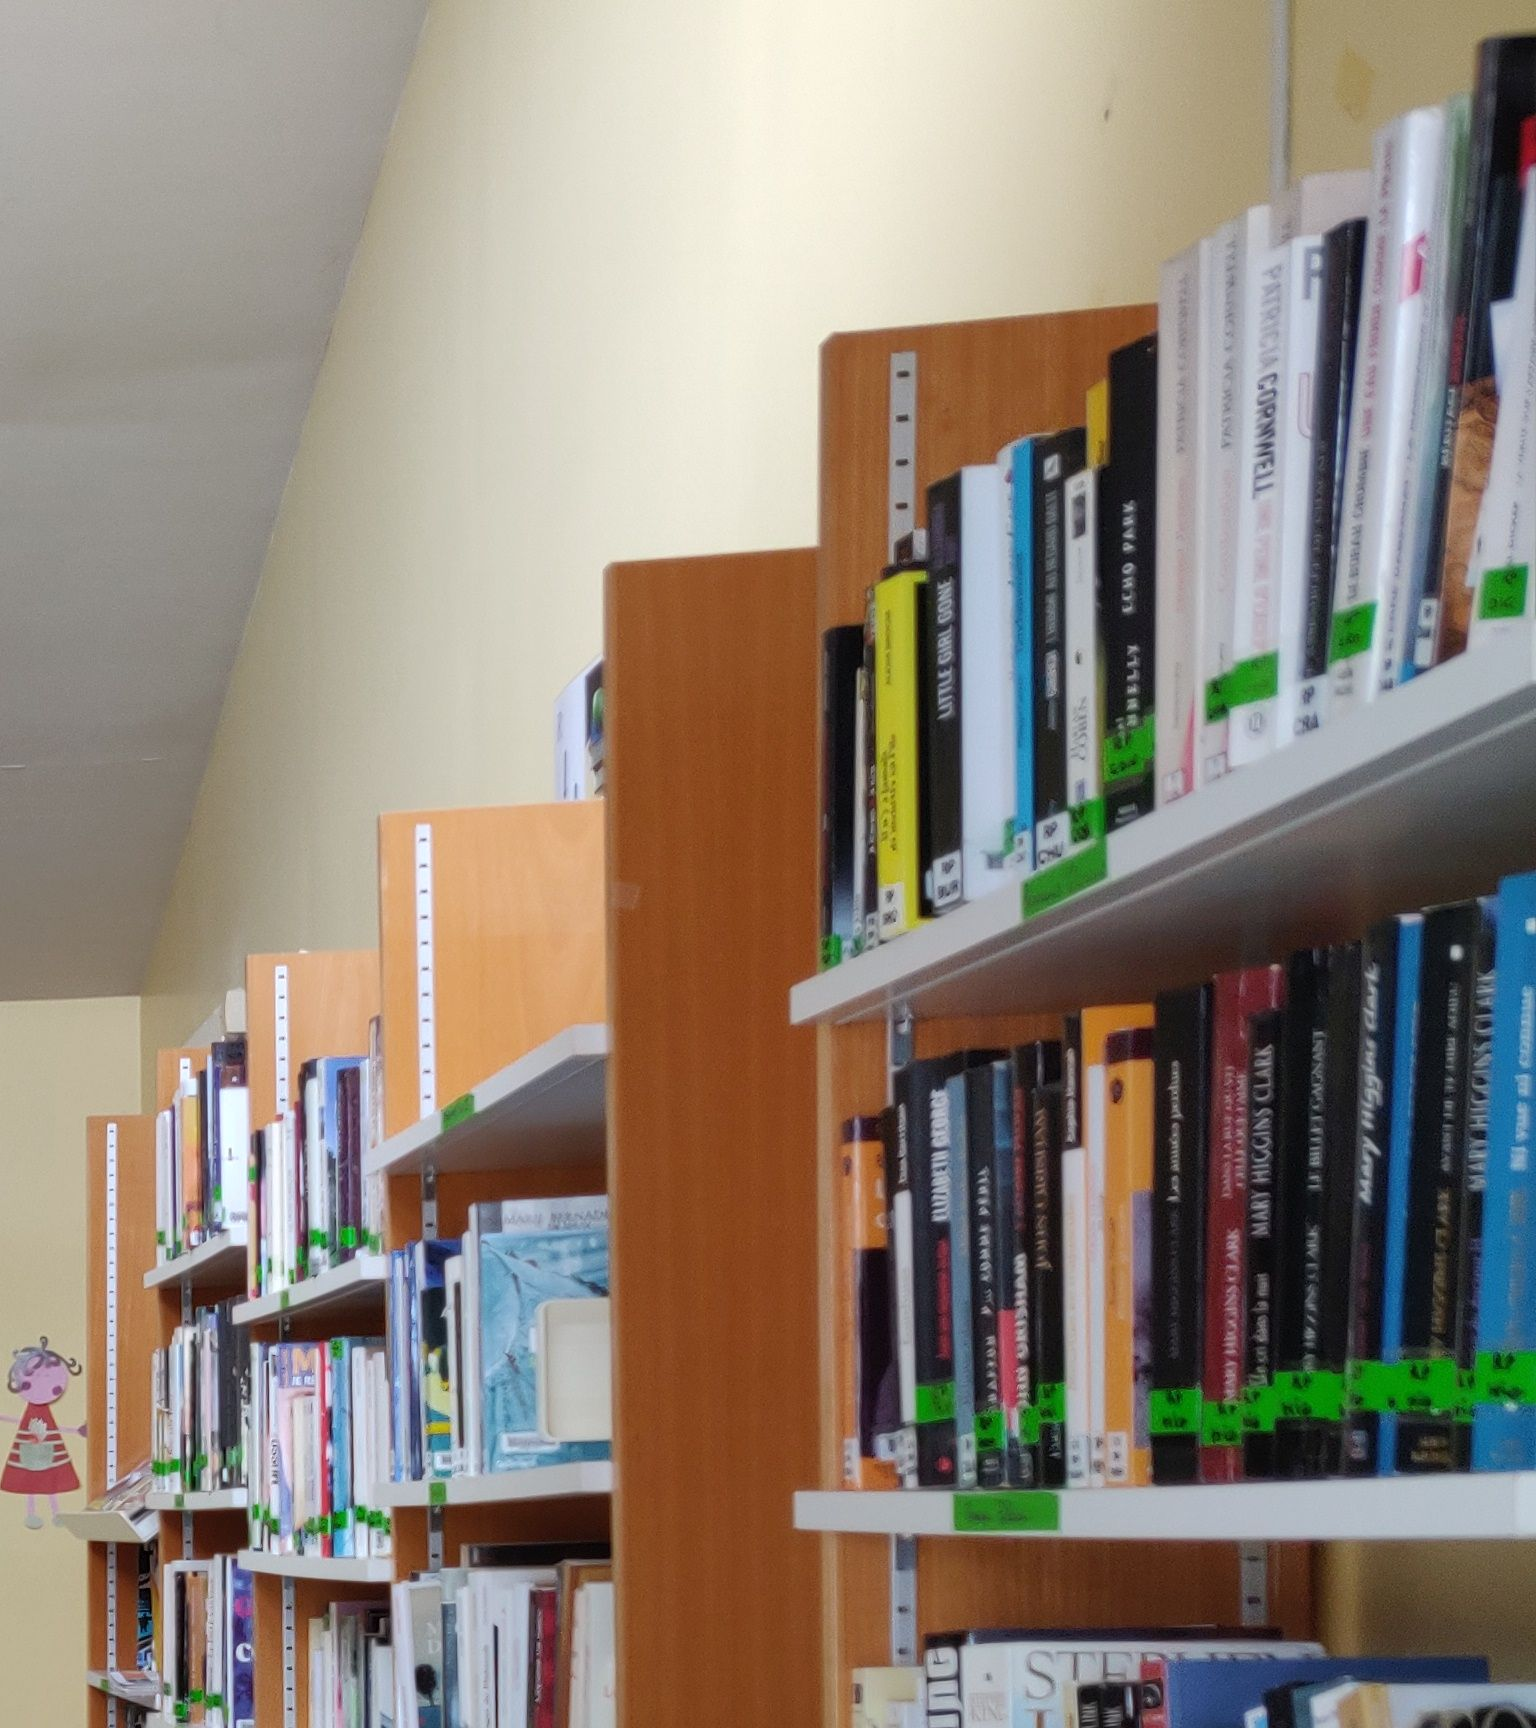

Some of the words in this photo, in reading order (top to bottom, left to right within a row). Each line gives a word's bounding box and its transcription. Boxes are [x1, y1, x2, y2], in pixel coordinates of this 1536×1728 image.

[1260, 265, 1282, 369] PATRICIA
[1251, 373, 1278, 499] CORNWELL
[1121, 500, 1137, 552] PARK
[936, 577, 954, 624] GONE
[1121, 562, 1137, 615] ECHO
[936, 626, 954, 664] GIRL
[936, 667, 955, 718] LITTLE
[1361, 962, 1379, 1035] Clark
[1472, 967, 1495, 1035] CLARK
[1168, 1060, 1183, 1118] perdues
[1251, 1044, 1274, 1102] CLARK
[1310, 1028, 1326, 1115] GAGNANT
[1358, 1041, 1383, 1130] Higgins
[1469, 1039, 1492, 1130] HIGGINS
[929, 1087, 948, 1148] GEORGE
[1250, 1107, 1273, 1184] HIGGINS
[1308, 1118, 1323, 1166] BILLET
[1168, 1122, 1180, 1174] années
[1356, 1135, 1379, 1204] Mary
[1467, 1136, 1488, 1191] MARY
[931, 1150, 949, 1223] ELIZABETH
[1168, 1177, 1179, 1201] Les
[1250, 1190, 1272, 1238] MARY
[1225, 1228, 1240, 1287] CLARK
[1255, 1272, 1269, 1298] nuit
[1225, 1290, 1240, 1354] HIGGINS
[1254, 1313, 1270, 1344] dans
